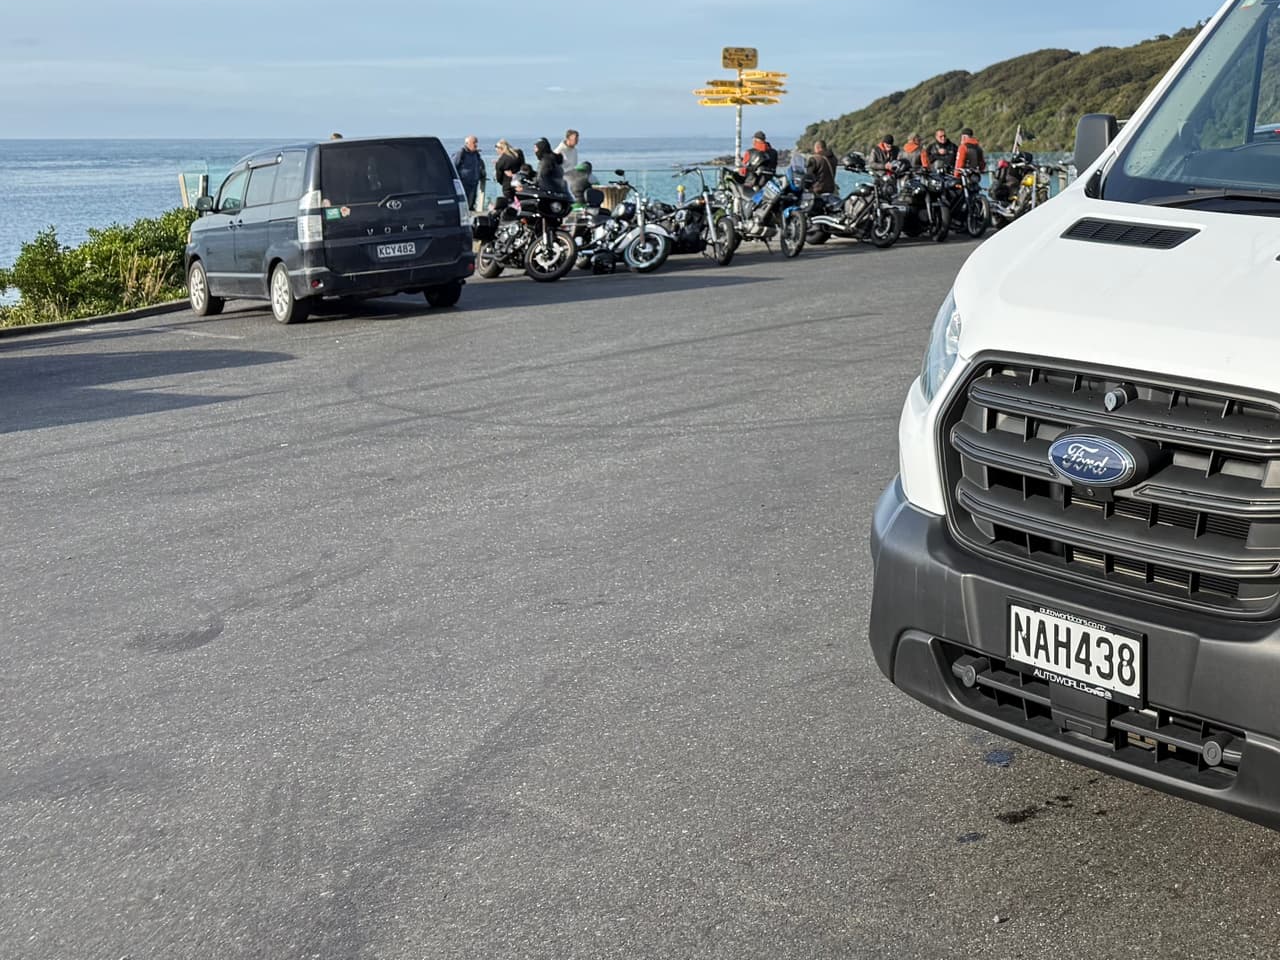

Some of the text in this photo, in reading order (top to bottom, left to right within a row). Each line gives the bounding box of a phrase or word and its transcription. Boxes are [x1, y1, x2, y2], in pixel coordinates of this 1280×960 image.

[366, 223, 425, 236] VOXY
[1062, 443, 1110, 474] Ford
[1014, 611, 1136, 687] NAH438
